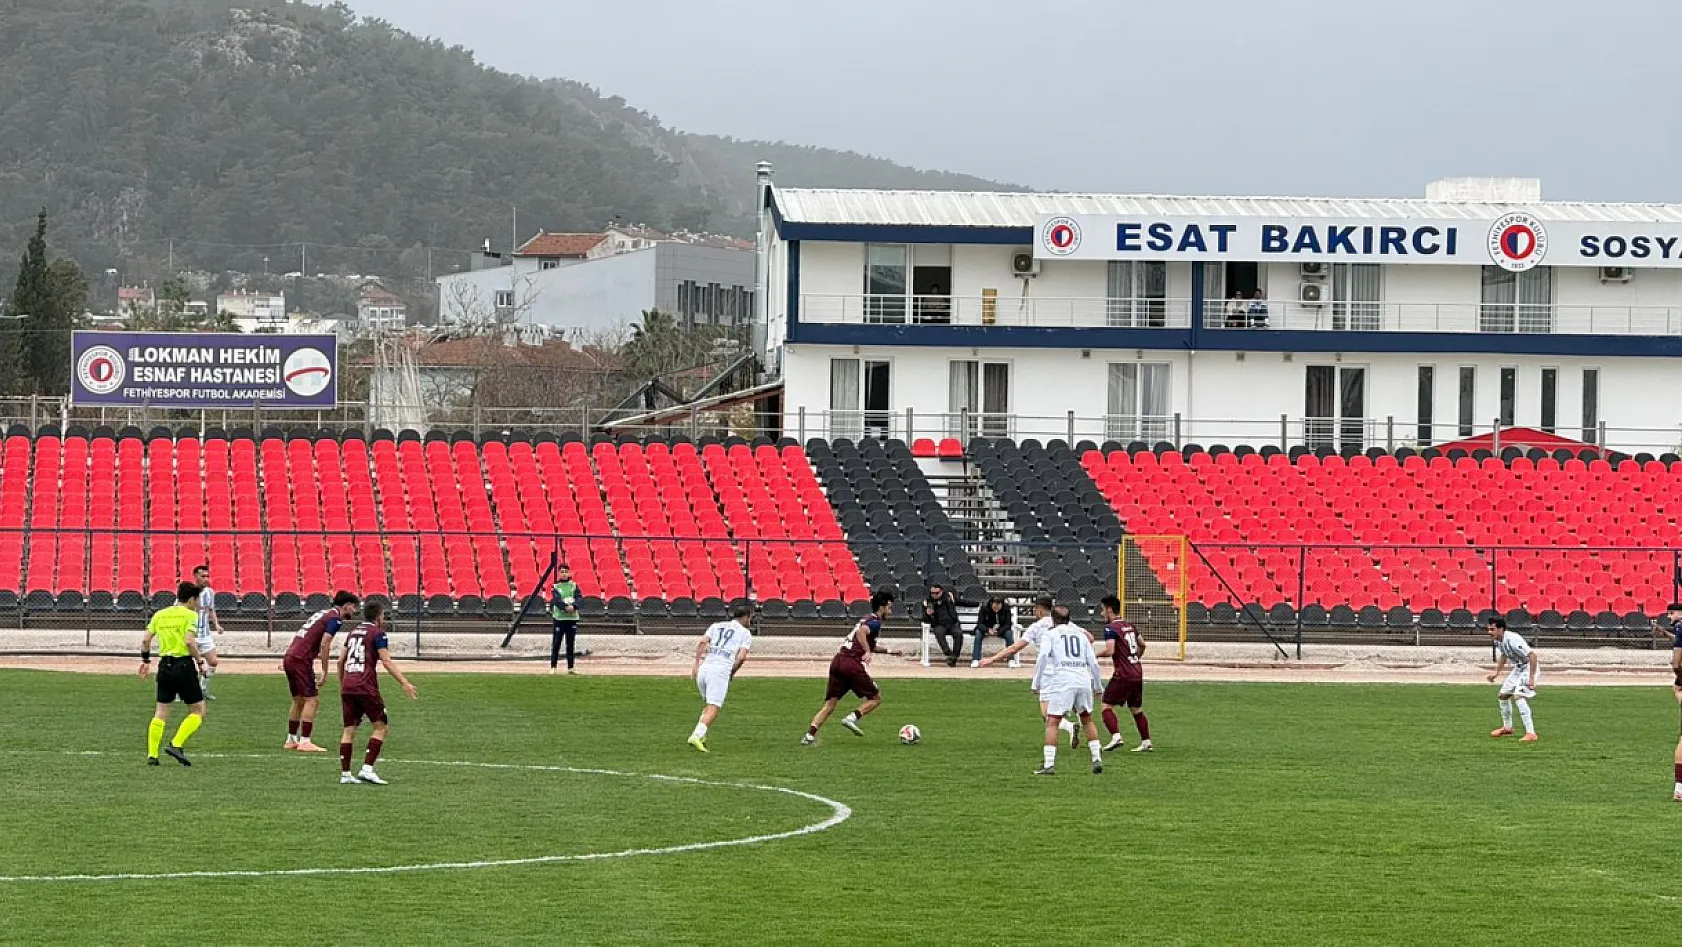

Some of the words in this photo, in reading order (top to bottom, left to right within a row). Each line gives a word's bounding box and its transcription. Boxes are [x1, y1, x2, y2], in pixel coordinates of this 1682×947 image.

[1116, 223, 1237, 252] ESAT
[1261, 224, 1457, 255] BAKIRCI
[1580, 235, 1682, 259] SOSY
[134, 347, 214, 364] LOKMAN
[219, 345, 280, 364] HEKİM
[133, 366, 187, 383] ESNAF
[190, 365, 280, 384] HASTANESİ
[122, 386, 190, 399] FETHİYESPOR
[193, 388, 231, 399] FUTBOL
[232, 387, 286, 400] AKADEMİSİ
[715, 627, 736, 649] 19
[1060, 634, 1081, 658] 10
[346, 636, 366, 664] 24
